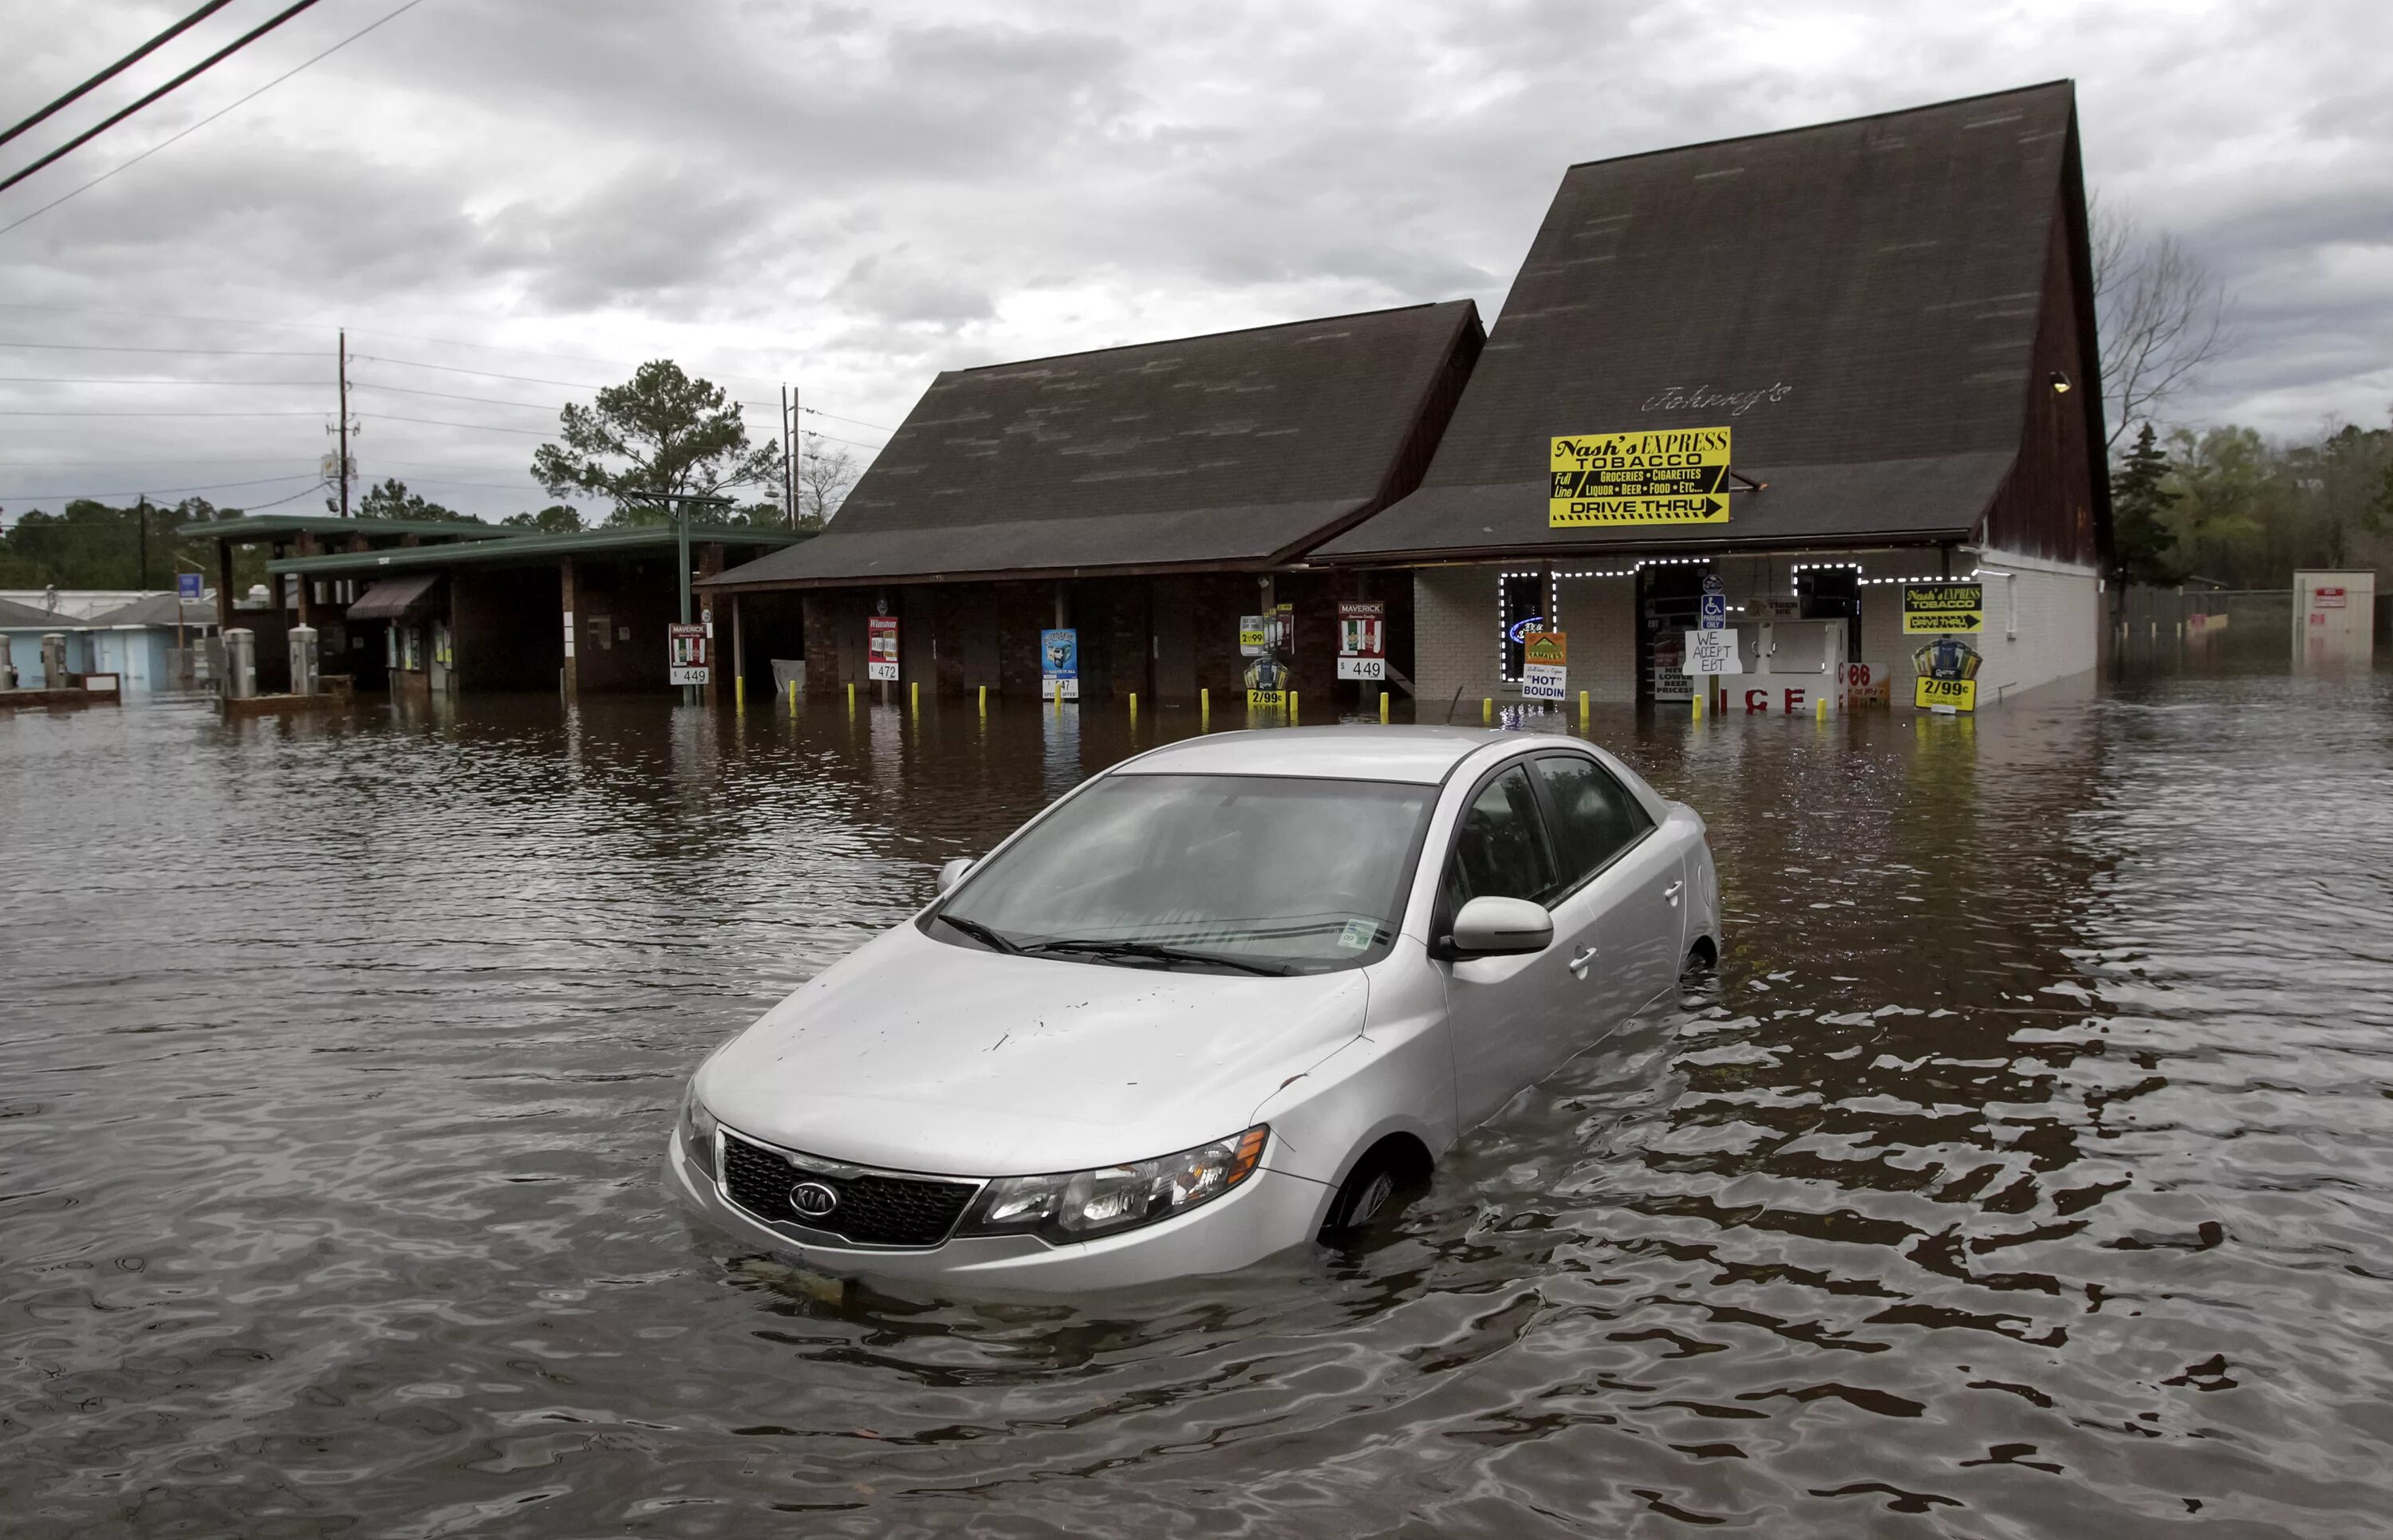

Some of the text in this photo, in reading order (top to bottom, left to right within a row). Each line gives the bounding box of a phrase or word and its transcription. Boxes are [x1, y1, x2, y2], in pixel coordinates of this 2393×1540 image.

[1555, 431, 1729, 457] Nash's EXPRESS
[1575, 453, 1702, 470] TOBACCO
[1555, 472, 1571, 485] Full
[1600, 469, 1701, 482] GROCERIES CIGARETTES
[1555, 486, 1573, 498] Line
[1586, 481, 1703, 496] LIQUOR BEER FOOD ETC...
[1570, 498, 1705, 514] DRIVE THRU
[1906, 587, 1981, 601] Nash's EXPRESS
[1911, 600, 1975, 609] TOBACCO
[870, 619, 897, 628] Winston
[1697, 631, 1719, 645] WE
[1528, 652, 1563, 660] TAMALES
[1693, 645, 1732, 660] ACCEPT
[878, 665, 896, 678] 472
[1701, 659, 1726, 672] EBT
[1527, 675, 1562, 685] "HOT"
[1524, 686, 1564, 697] BOUDIN
[796, 1188, 826, 1211] KIA
